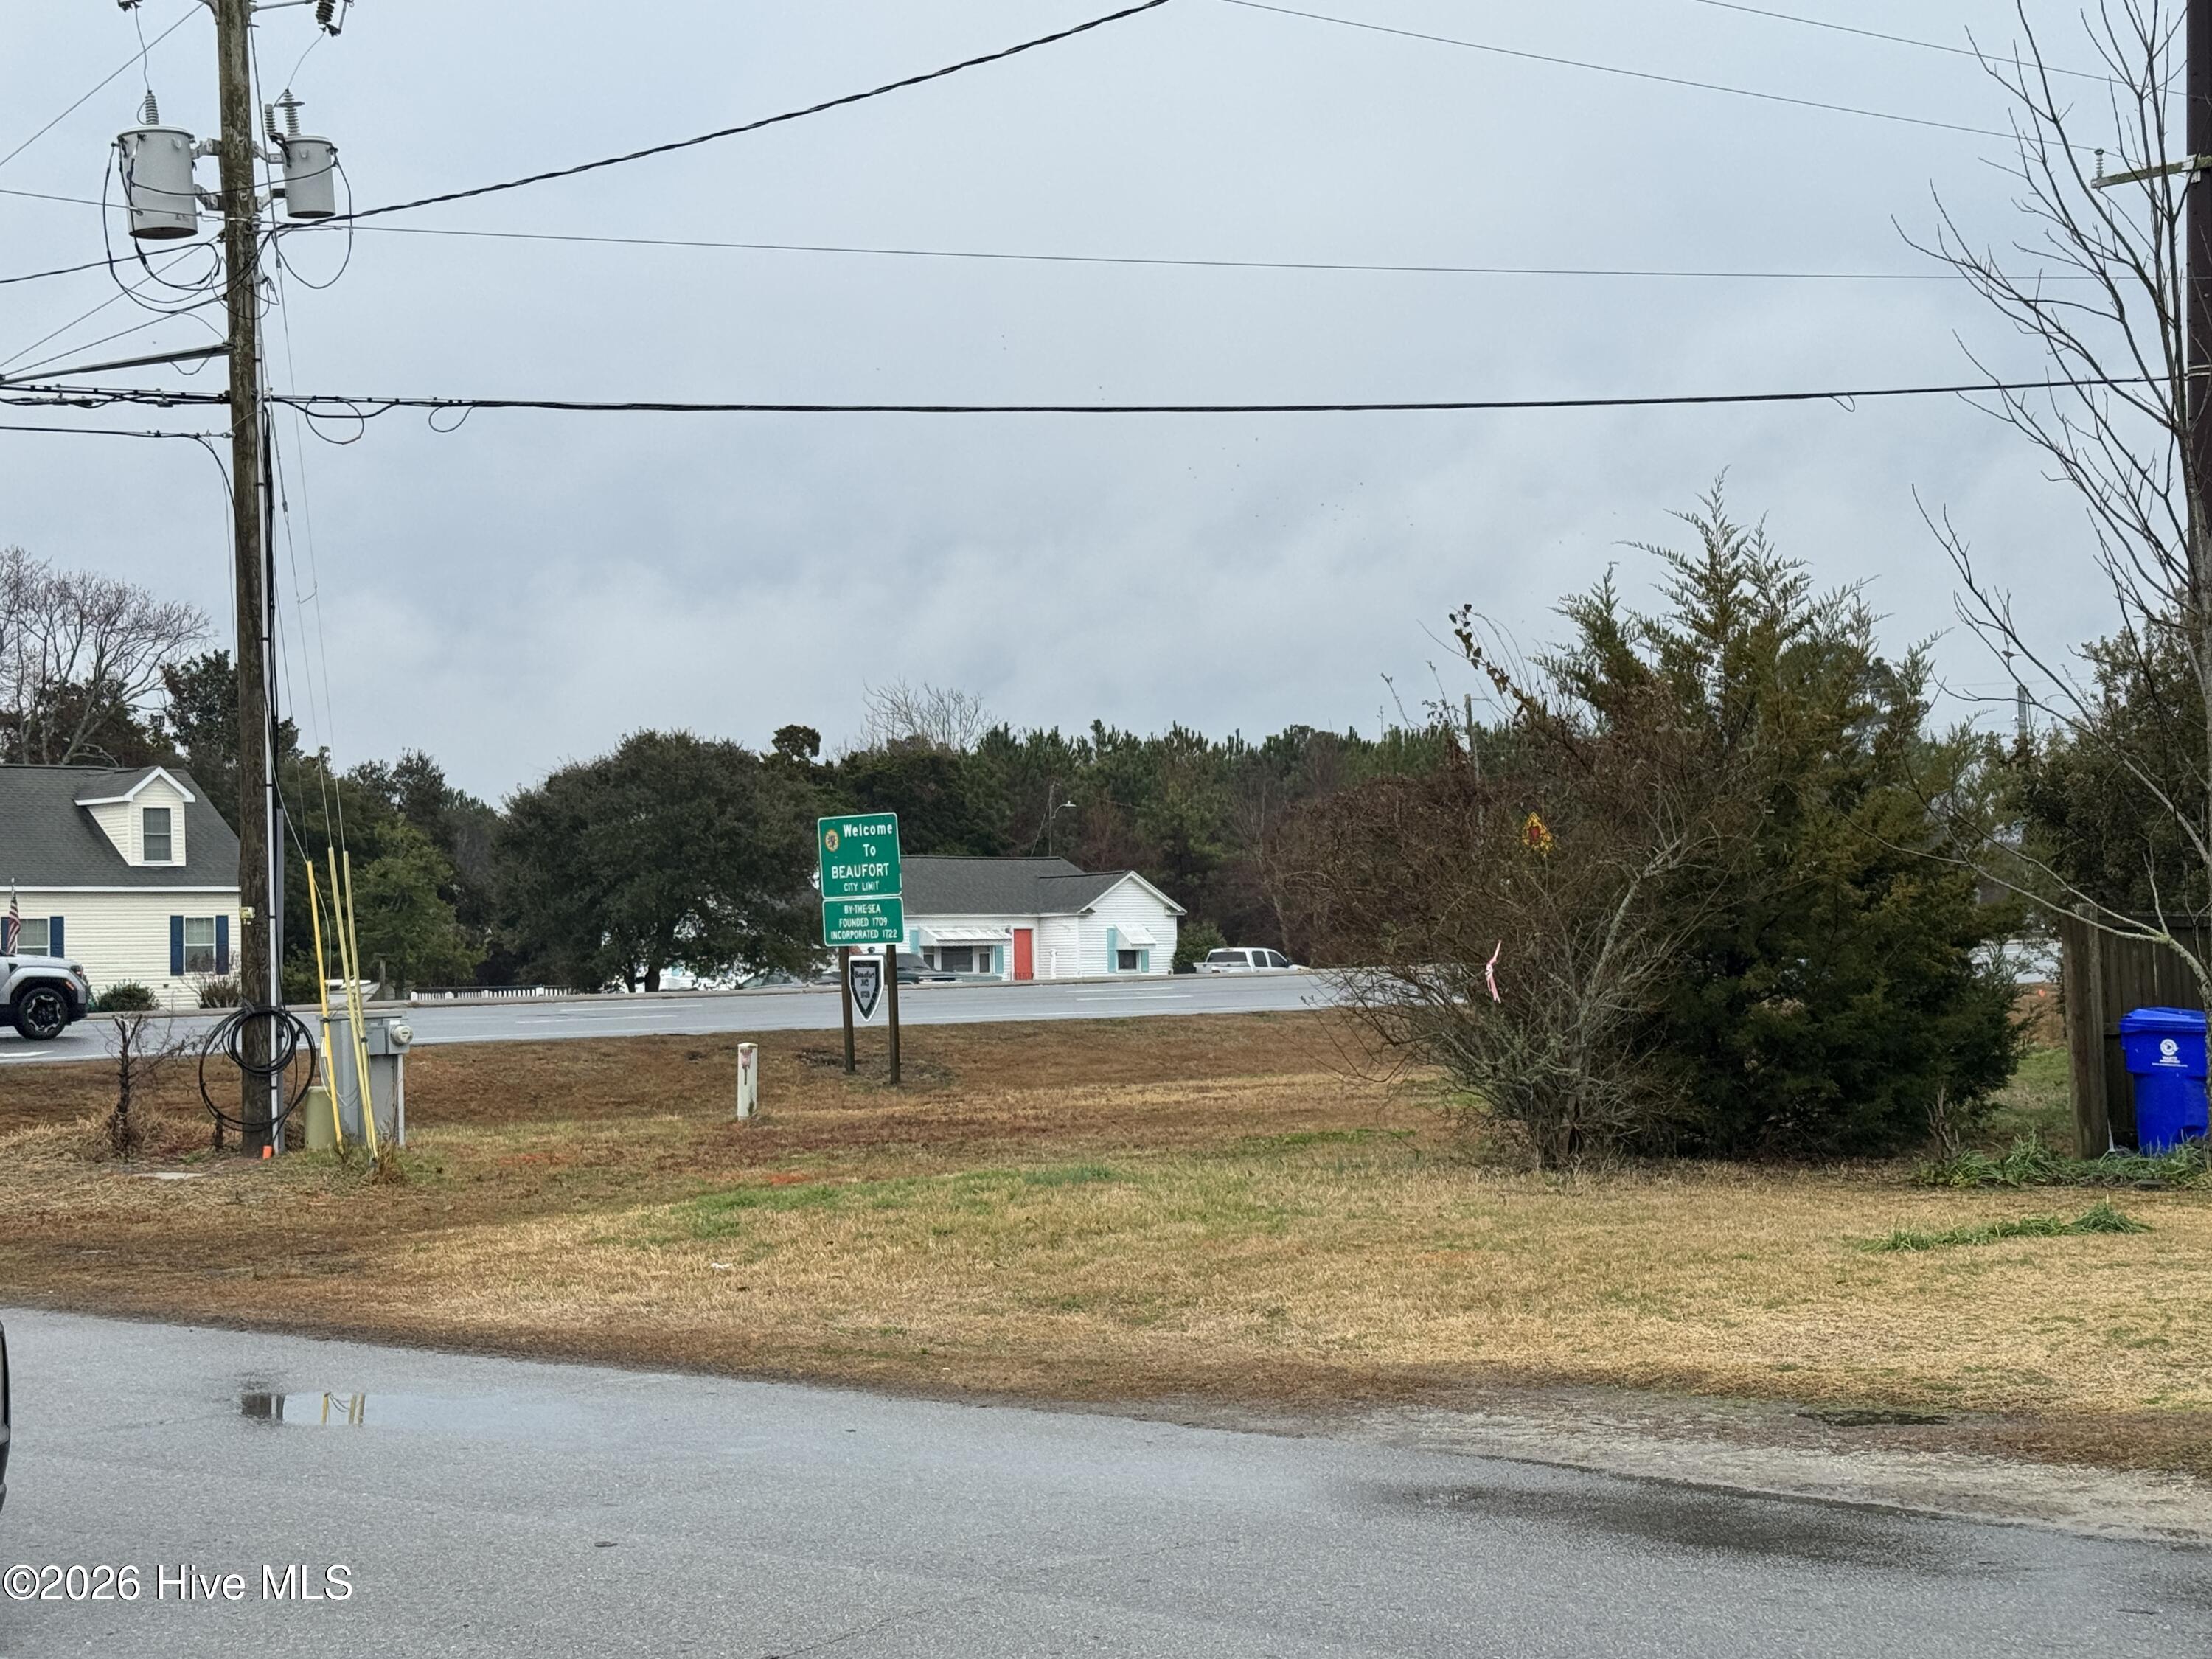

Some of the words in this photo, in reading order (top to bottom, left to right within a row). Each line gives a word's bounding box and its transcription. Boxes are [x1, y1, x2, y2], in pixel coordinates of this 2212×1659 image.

[843, 824, 893, 838] Welcome
[863, 844, 876, 857] To
[831, 863, 889, 880] BEAUFORT
[844, 882, 858, 892] CITY
[862, 881, 880, 891] LIMIT
[838, 917, 869, 928] FOUNDED
[872, 917, 888, 926] 1709
[830, 930, 879, 940] INCORPORATED
[882, 929, 897, 939] 1722
